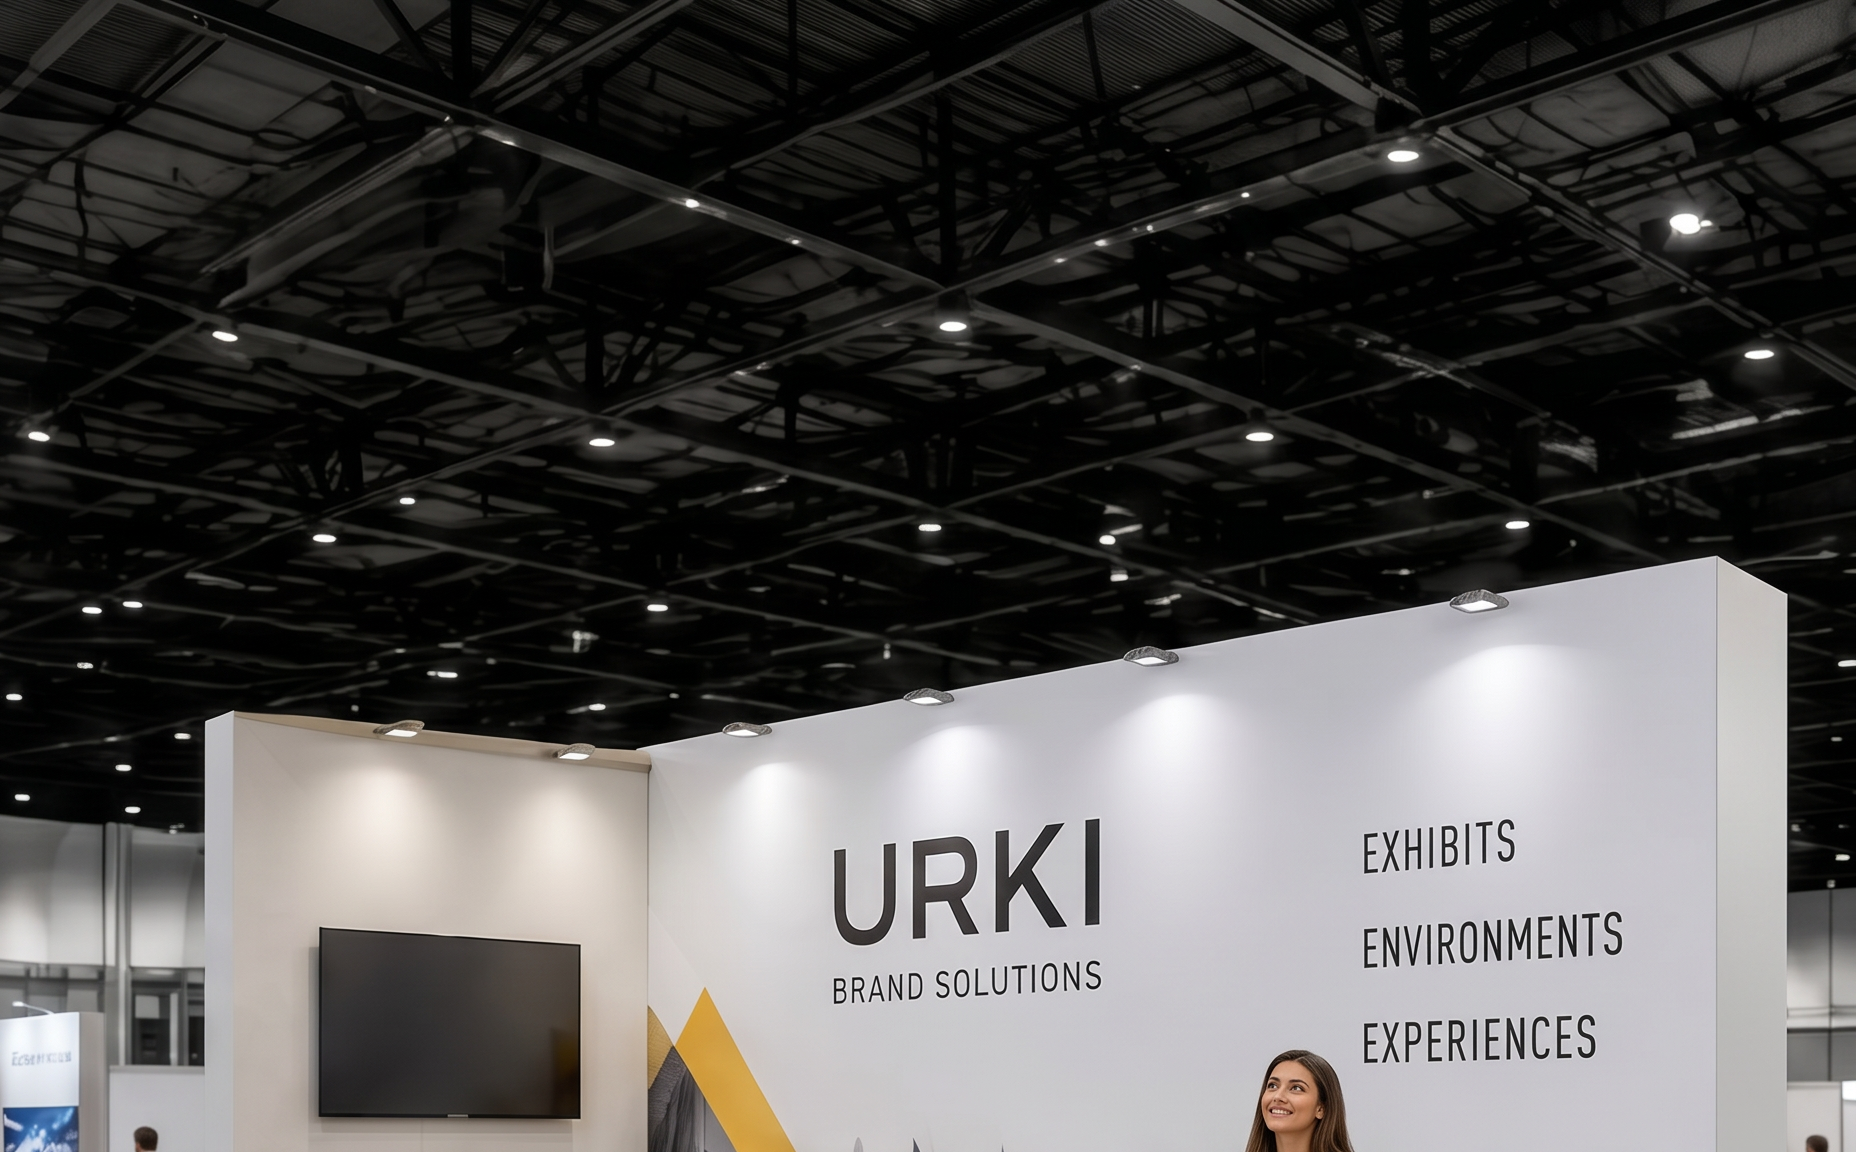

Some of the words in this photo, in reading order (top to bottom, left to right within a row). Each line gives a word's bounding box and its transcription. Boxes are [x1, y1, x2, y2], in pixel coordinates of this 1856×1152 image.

[1363, 819, 1516, 874] EXHIBITS
[833, 818, 1101, 946] URKI
[1363, 911, 1623, 969] ENVIRONMENTS
[833, 972, 923, 1005] BRAND
[935, 960, 1102, 999] SOLUTIONS
[1363, 1014, 1597, 1064] EXPERIENCES
